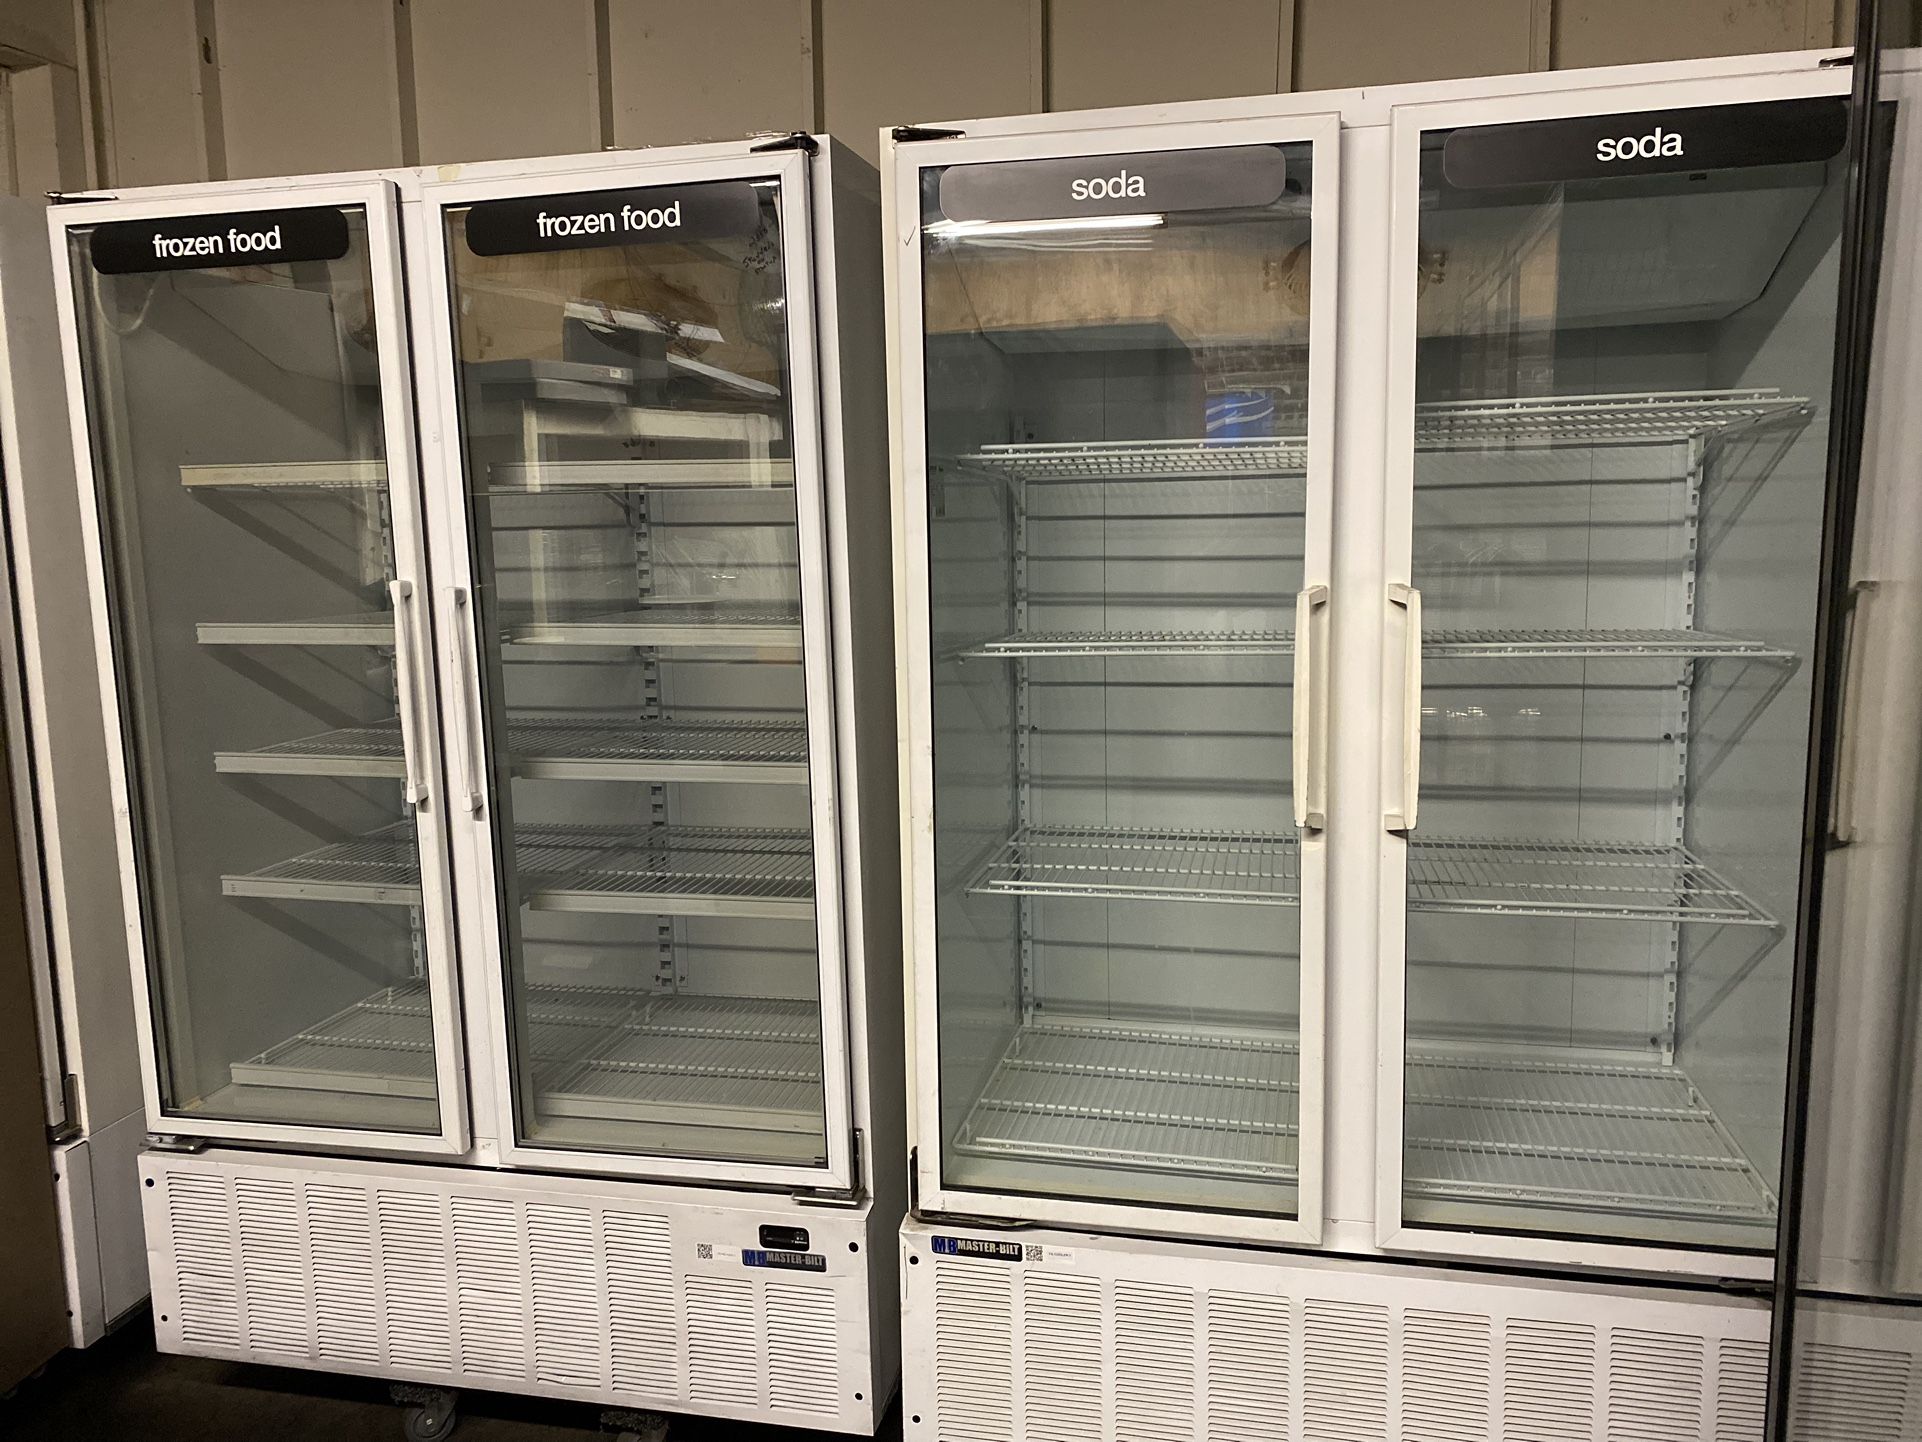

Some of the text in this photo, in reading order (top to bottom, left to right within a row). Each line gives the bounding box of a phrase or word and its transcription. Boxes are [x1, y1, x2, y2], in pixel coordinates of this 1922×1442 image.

[1596, 127, 1683, 162] soda
[1071, 169, 1146, 200] soda
[536, 200, 681, 238] frozen food
[152, 224, 282, 258] frozen food
[766, 1251, 824, 1267] MASTER-BILT
[957, 1239, 1020, 1256] MASTER-BILT
